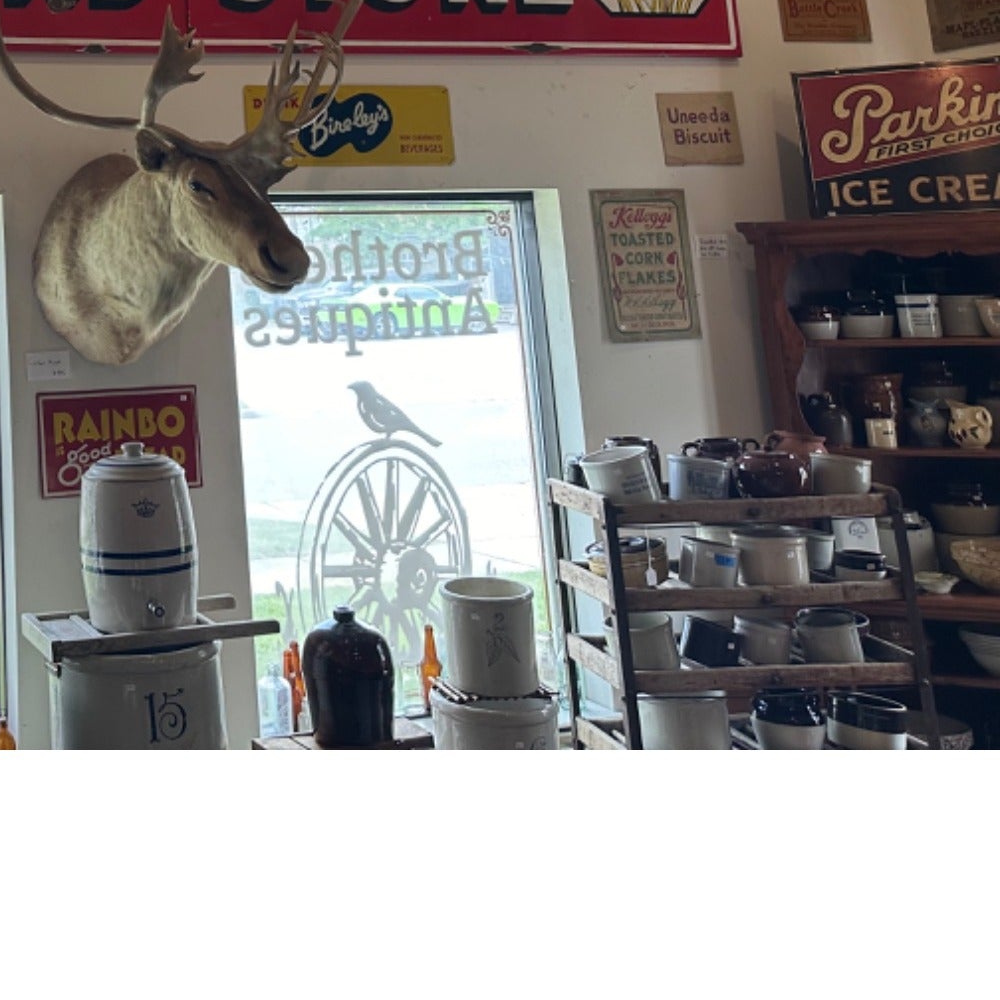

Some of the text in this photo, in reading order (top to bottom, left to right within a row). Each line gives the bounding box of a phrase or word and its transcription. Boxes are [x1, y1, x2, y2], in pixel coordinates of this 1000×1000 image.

[666, 106, 731, 124] Uneeda
[674, 127, 732, 145] Biscuit
[876, 137, 934, 159] FIRST
[829, 174, 1000, 208] ICE CRE
[609, 232, 674, 247] TOASTED
[625, 251, 663, 265] CORN
[618, 270, 675, 285] FLAKES
[52, 405, 186, 445] RAINBO
[143, 687, 188, 744] 15
